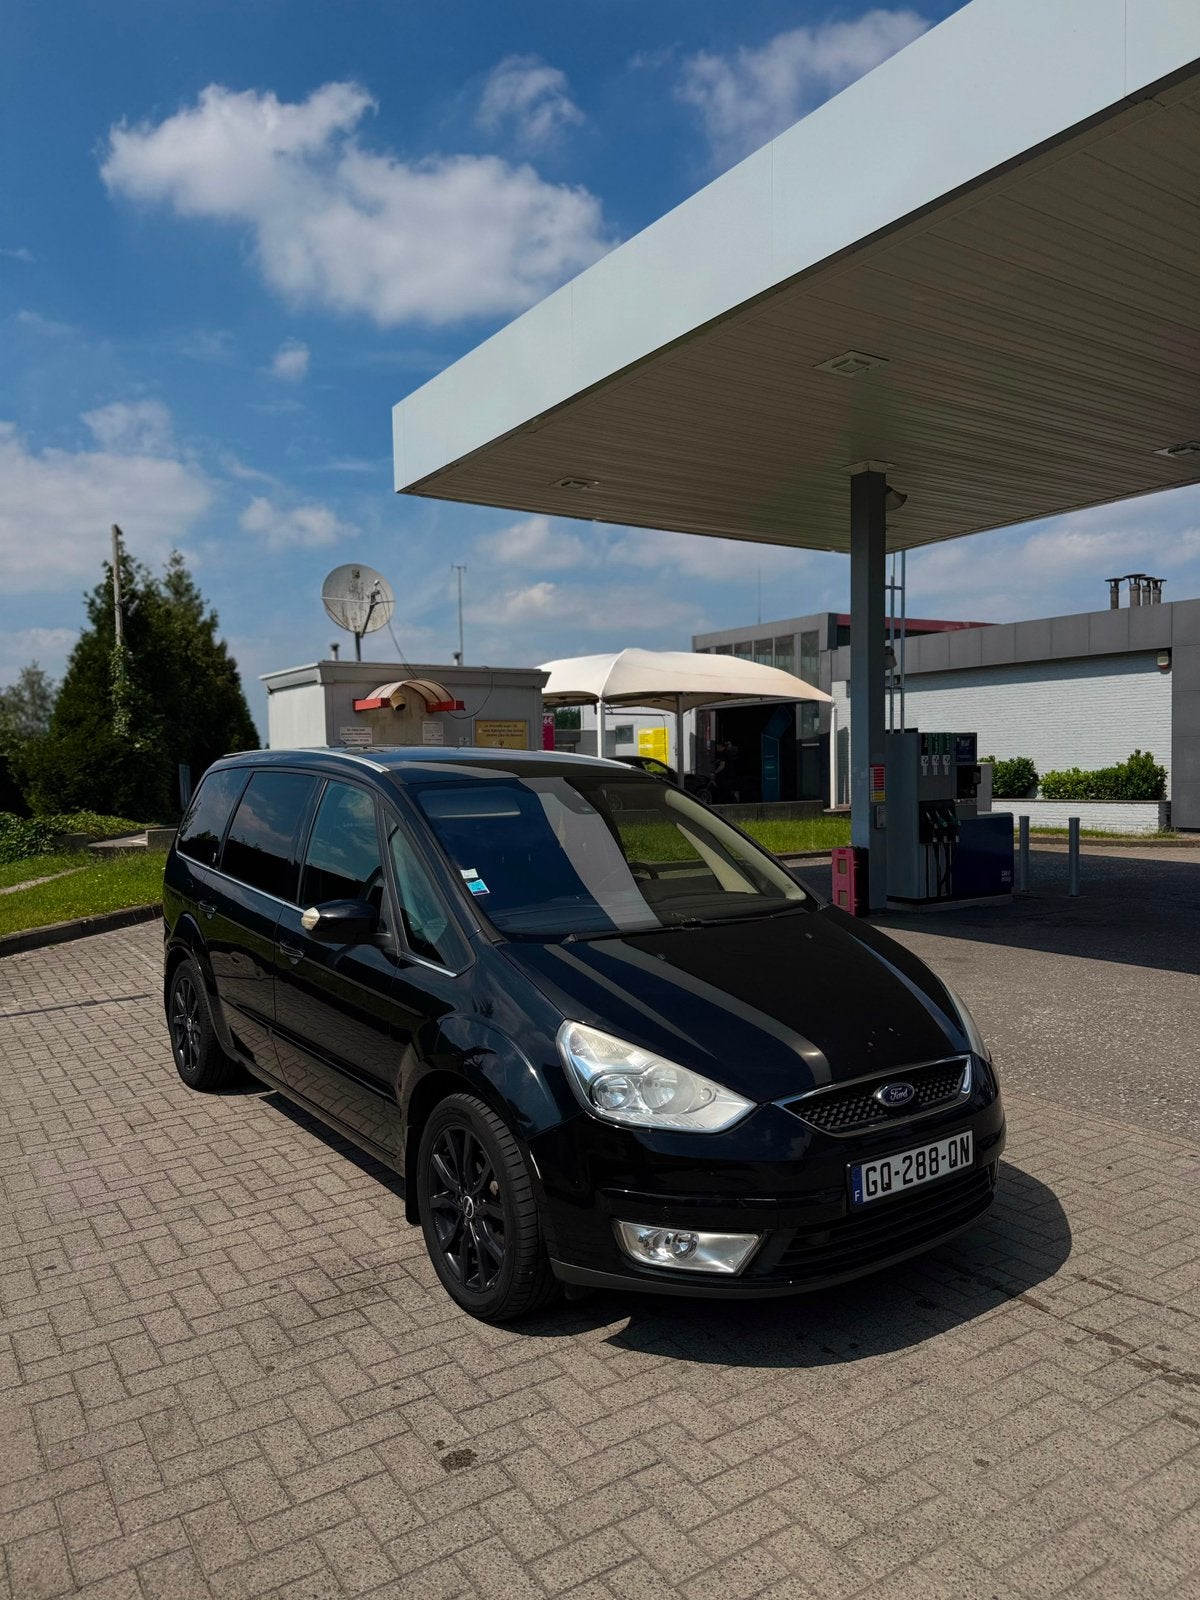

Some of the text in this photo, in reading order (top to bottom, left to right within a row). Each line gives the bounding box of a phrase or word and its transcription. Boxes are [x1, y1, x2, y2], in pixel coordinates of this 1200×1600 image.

[890, 1087, 908, 1101] Ford
[865, 1135, 970, 1197] GQ-288-QN
[854, 1190, 860, 1202] F
